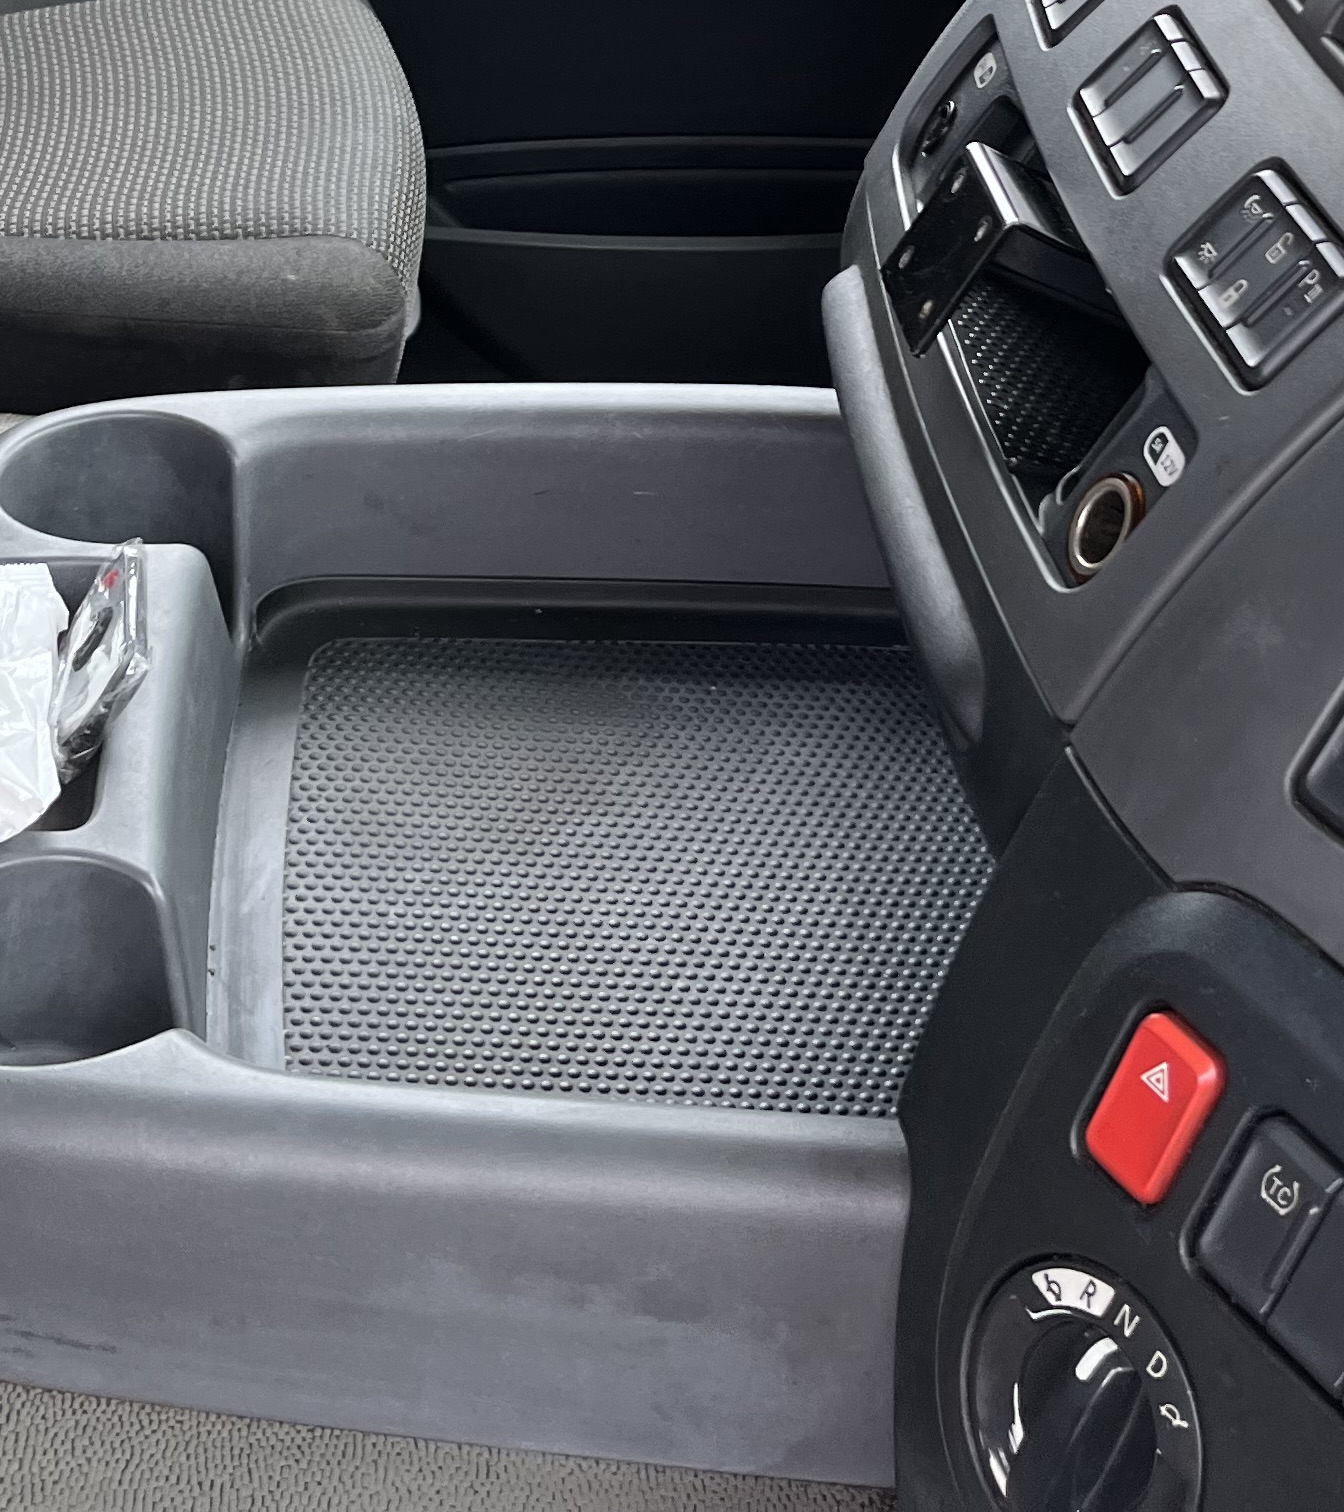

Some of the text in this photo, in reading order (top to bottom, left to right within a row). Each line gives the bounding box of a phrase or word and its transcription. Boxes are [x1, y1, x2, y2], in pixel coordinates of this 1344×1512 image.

[1269, 1175, 1293, 1206] TC
[1079, 1279, 1098, 1310] R
[1113, 1303, 1141, 1338] N
[1145, 1349, 1168, 1378] D
